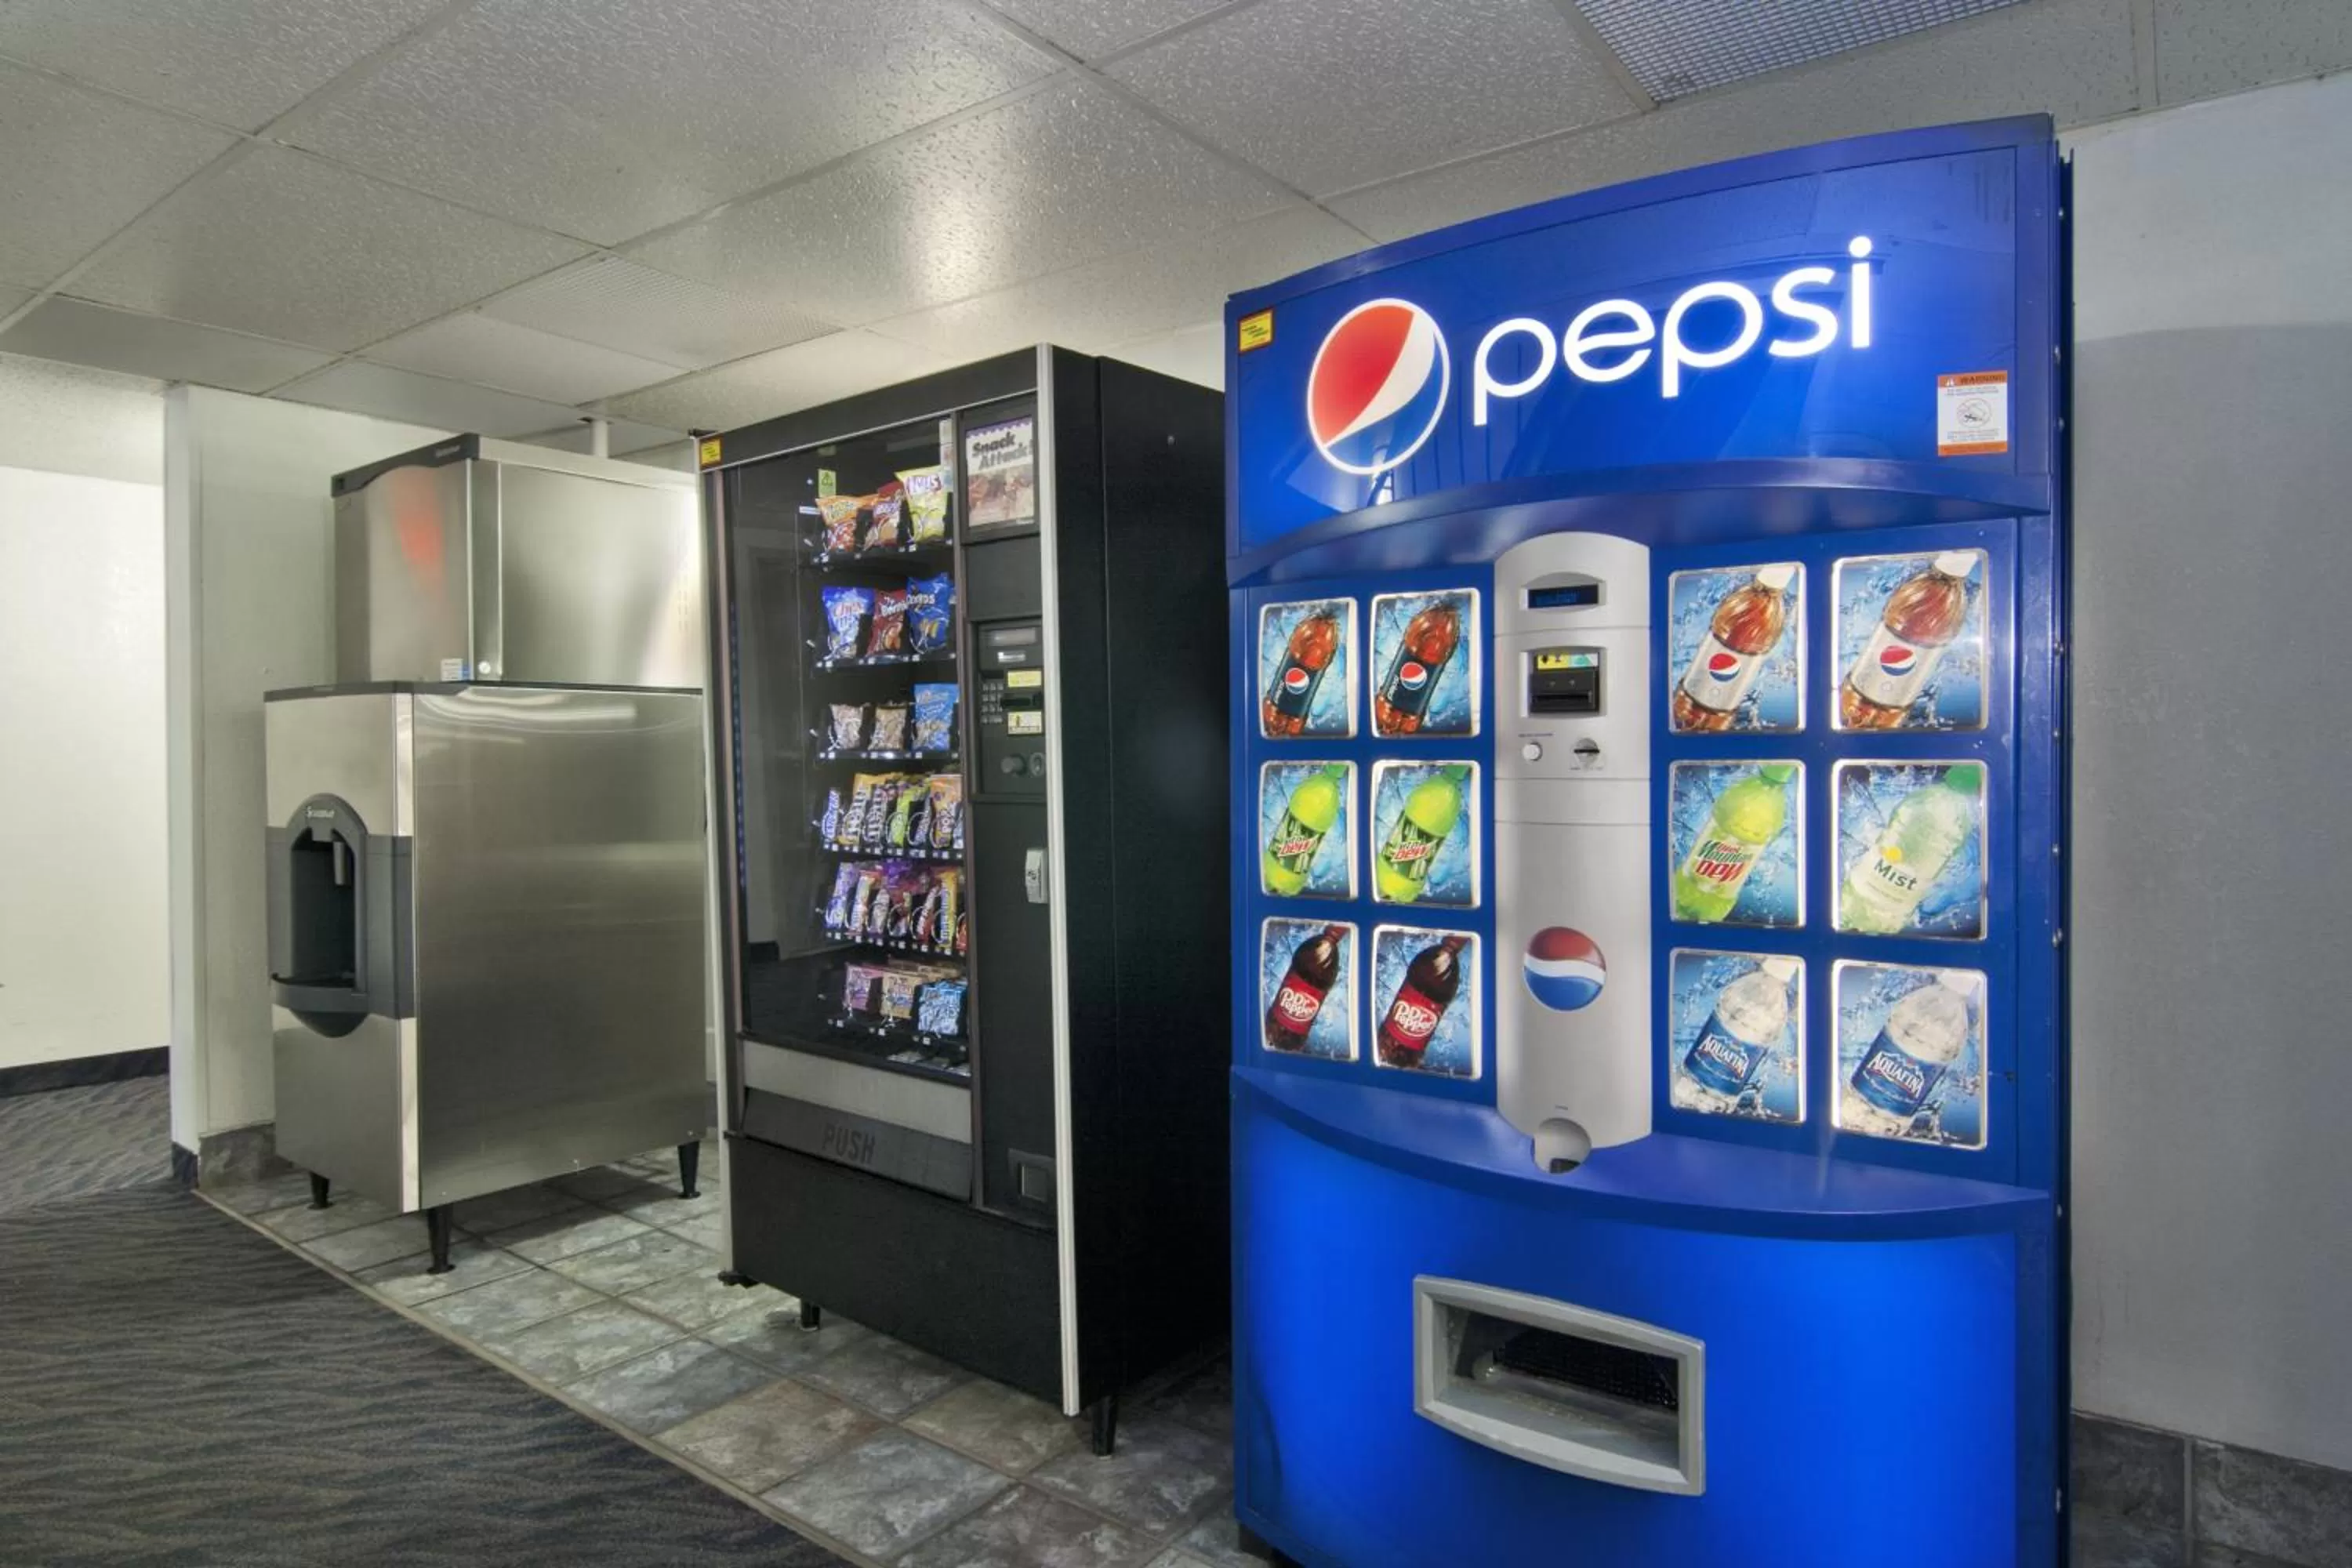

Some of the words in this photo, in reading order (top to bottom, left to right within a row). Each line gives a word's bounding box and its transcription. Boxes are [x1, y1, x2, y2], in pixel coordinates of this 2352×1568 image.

[1473, 235, 1873, 426] pepsi
[973, 431, 1016, 452] Snack
[1697, 1033, 1749, 1080] AQUAFINA
[1867, 1051, 1924, 1098] AQUAFINA
[821, 1123, 876, 1164] PUSH
